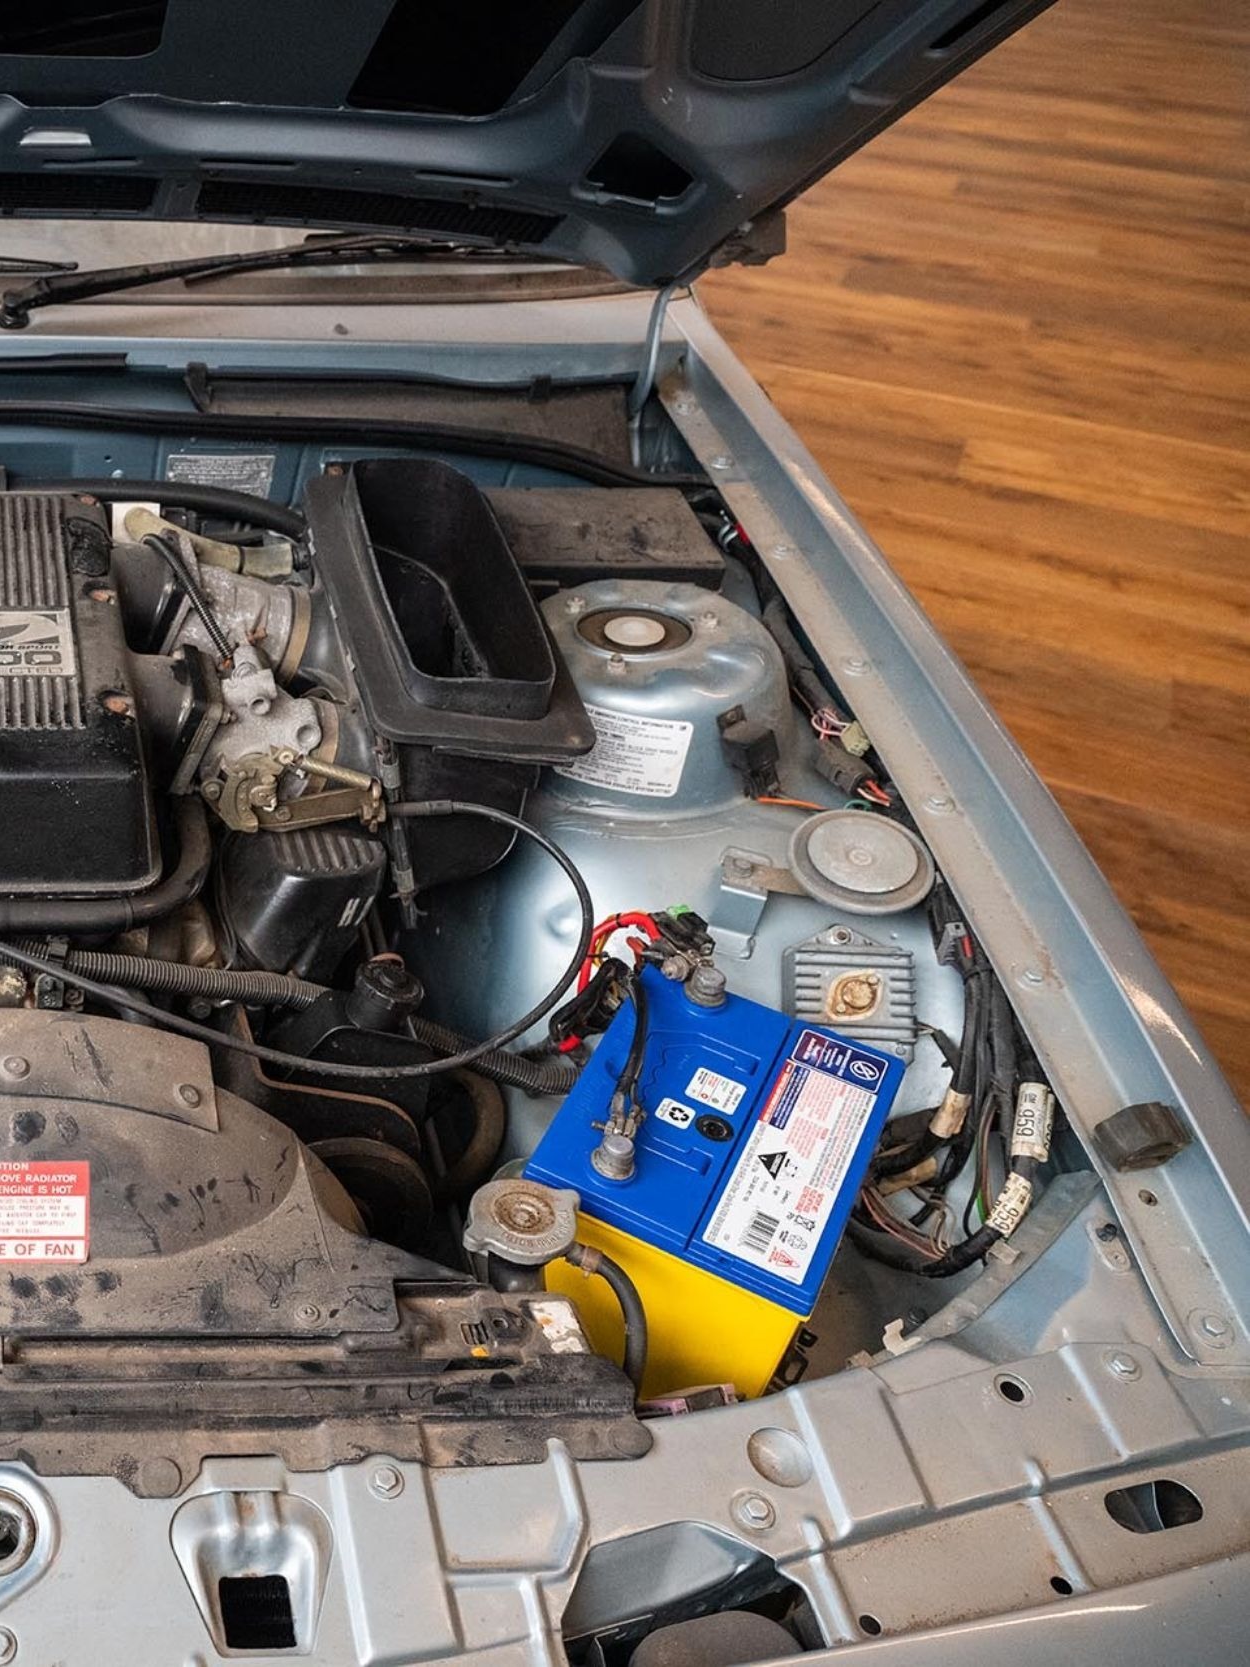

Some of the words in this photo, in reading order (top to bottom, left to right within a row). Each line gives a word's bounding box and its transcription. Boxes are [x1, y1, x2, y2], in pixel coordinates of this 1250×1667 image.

[1015, 1109, 1035, 1137] 959
[26, 1174, 77, 1182] RADIATOR
[38, 1186, 47, 1194] IS
[51, 1186, 73, 1194] HOT
[14, 1243, 36, 1256] OF
[44, 1243, 75, 1256] FAN
